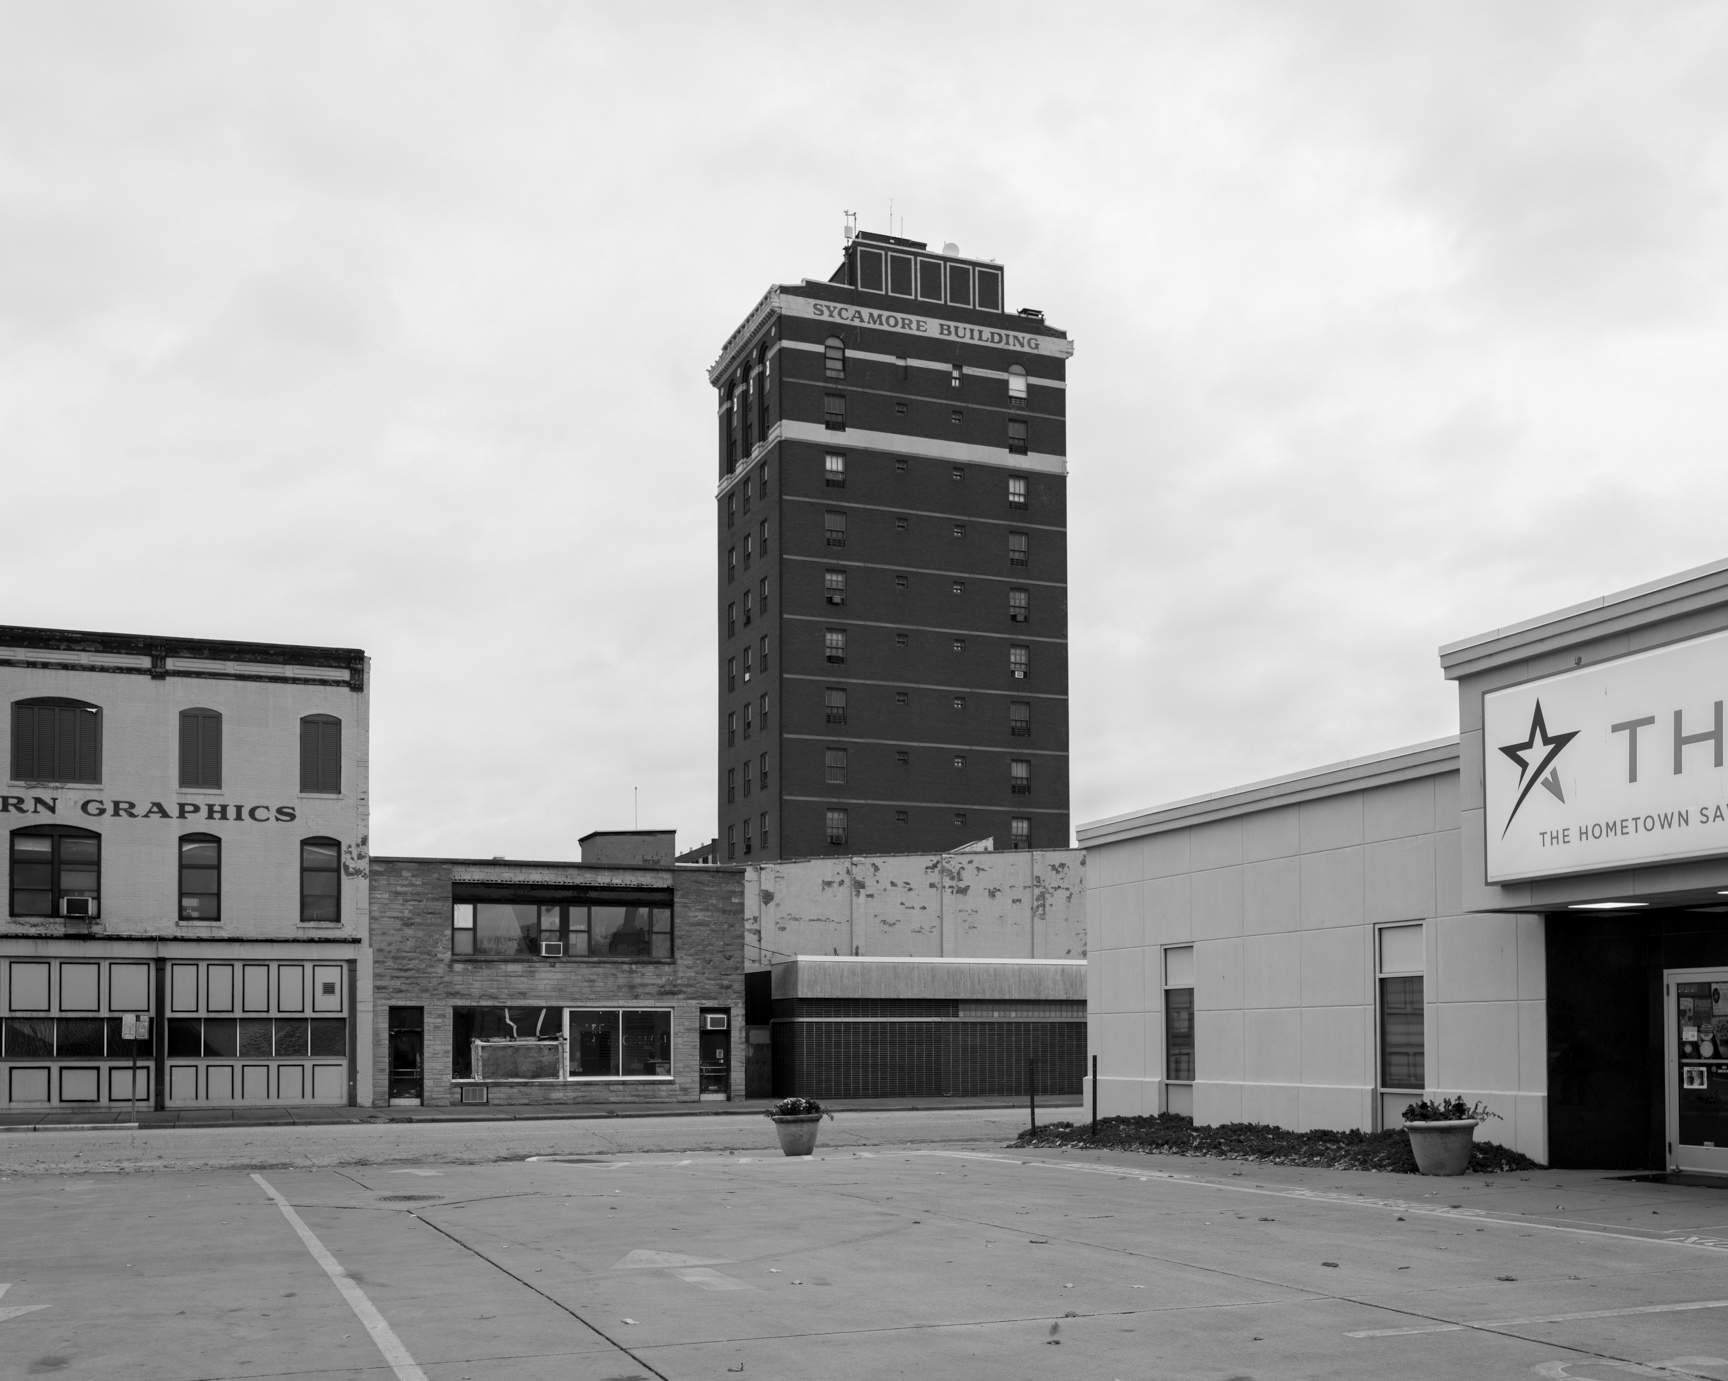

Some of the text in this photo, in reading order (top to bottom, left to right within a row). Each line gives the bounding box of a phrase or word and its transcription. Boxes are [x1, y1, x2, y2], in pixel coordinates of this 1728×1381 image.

[812, 302, 1040, 350] SYCAMORE BUILDING
[1611, 699, 1724, 783] TH
[0, 795, 297, 823] RN GRAPHICS
[1539, 803, 1728, 848] THE HOMETOWN SA
